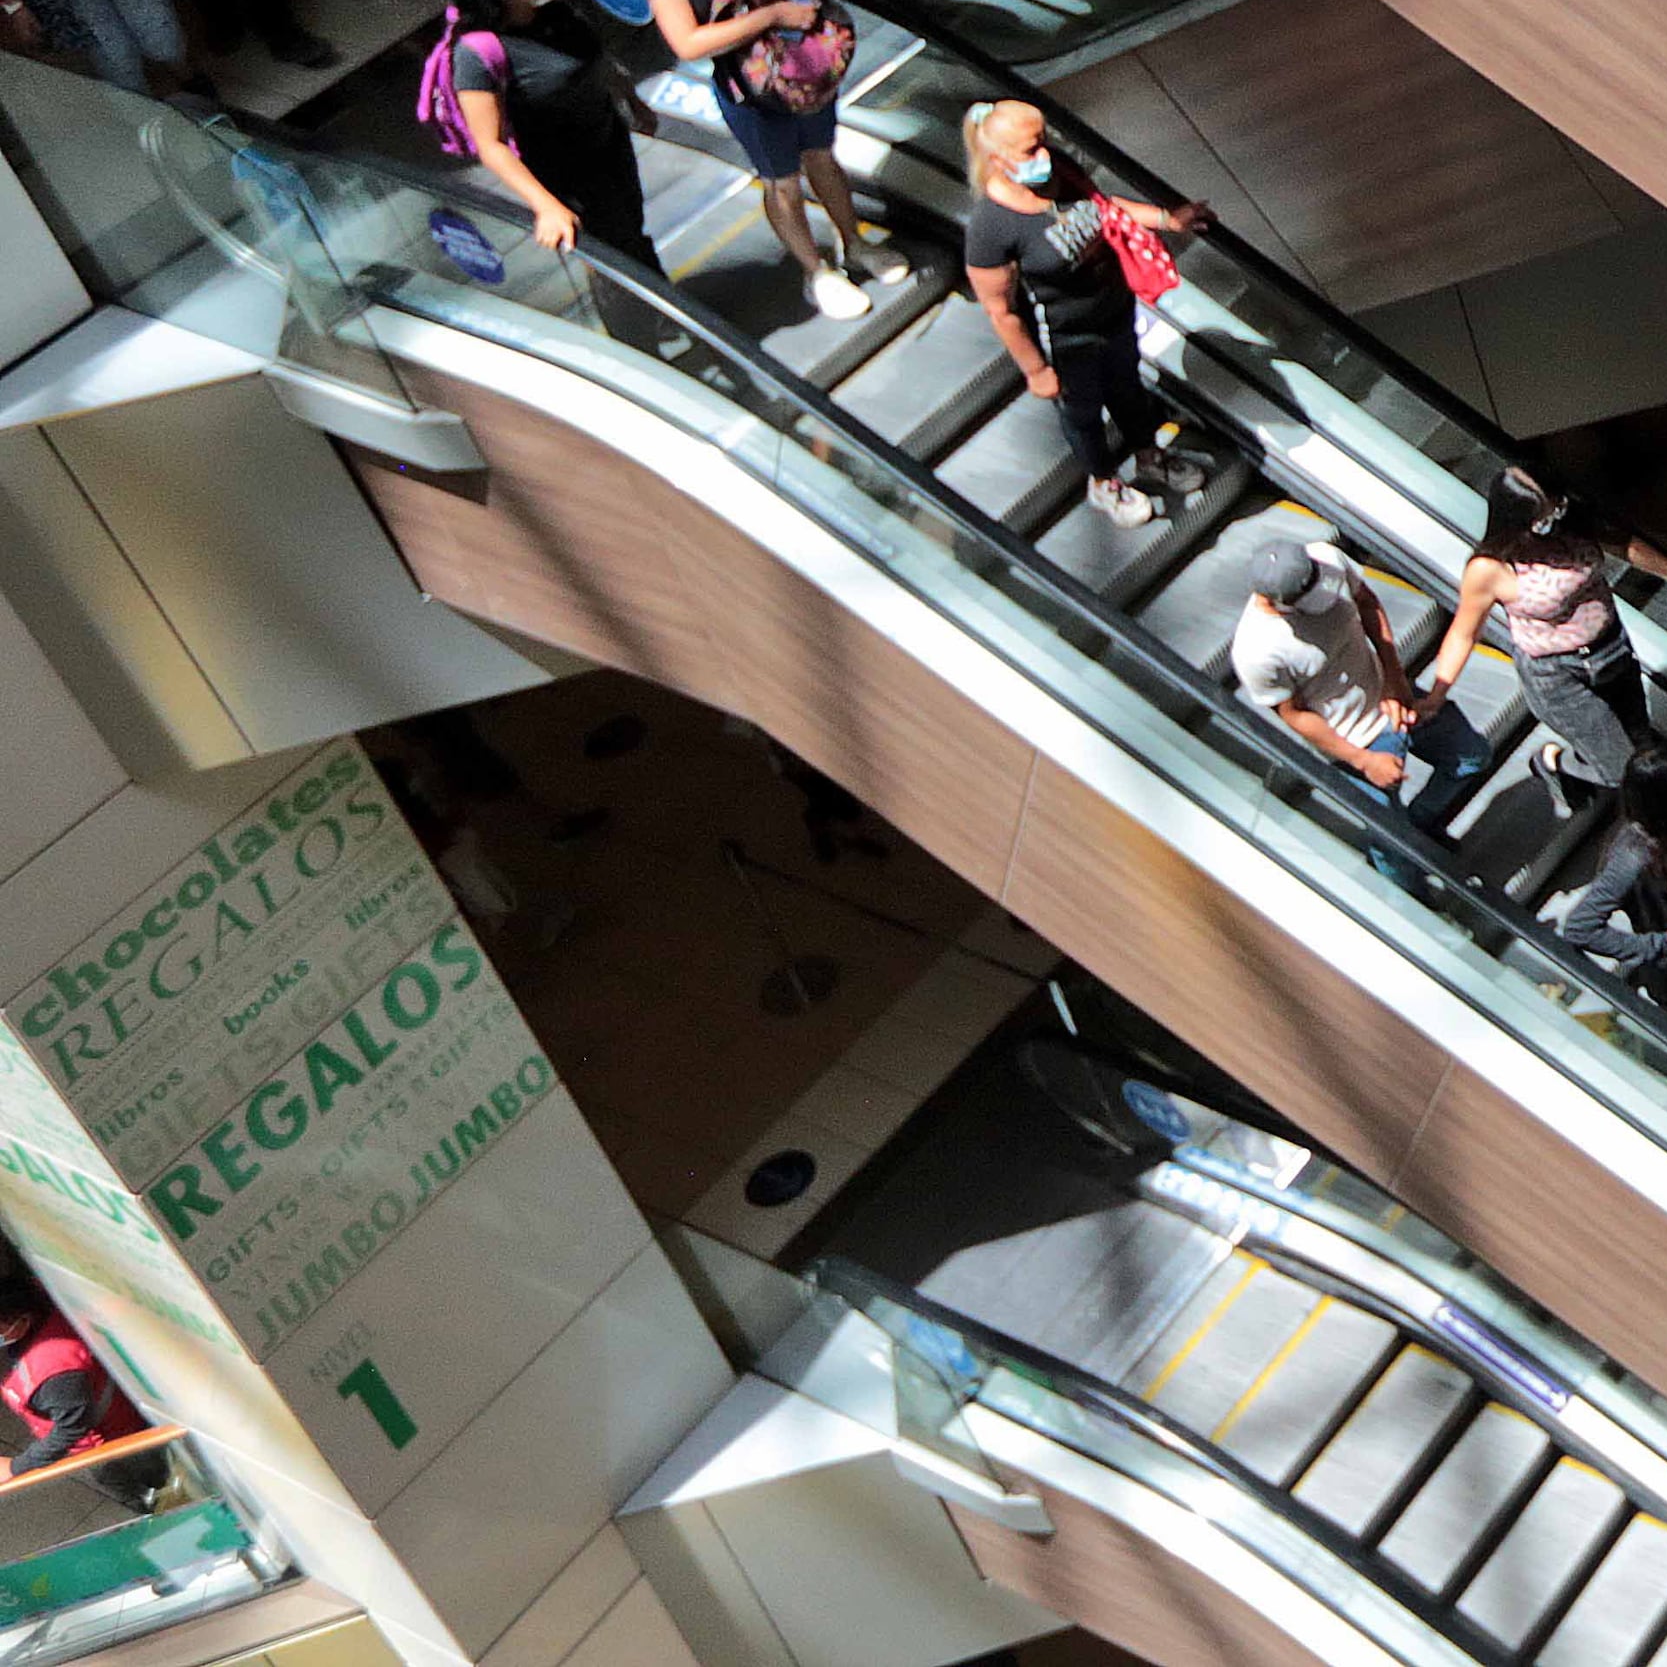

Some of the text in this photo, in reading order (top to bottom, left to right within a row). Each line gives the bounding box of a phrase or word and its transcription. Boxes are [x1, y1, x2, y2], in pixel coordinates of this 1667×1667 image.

[20, 749, 363, 1036] chocolates
[48, 780, 390, 1088] REGALOS
[93, 1063, 186, 1147] libros
[221, 957, 313, 1037] books
[344, 862, 425, 931] libros
[143, 924, 484, 1244] REGALOS
[200, 1194, 304, 1287] GIFTS
[319, 1094, 411, 1178] GIFTS
[253, 1187, 411, 1352] JUMBO
[412, 1056, 553, 1192] JUMBO
[335, 1356, 421, 1450] 1
